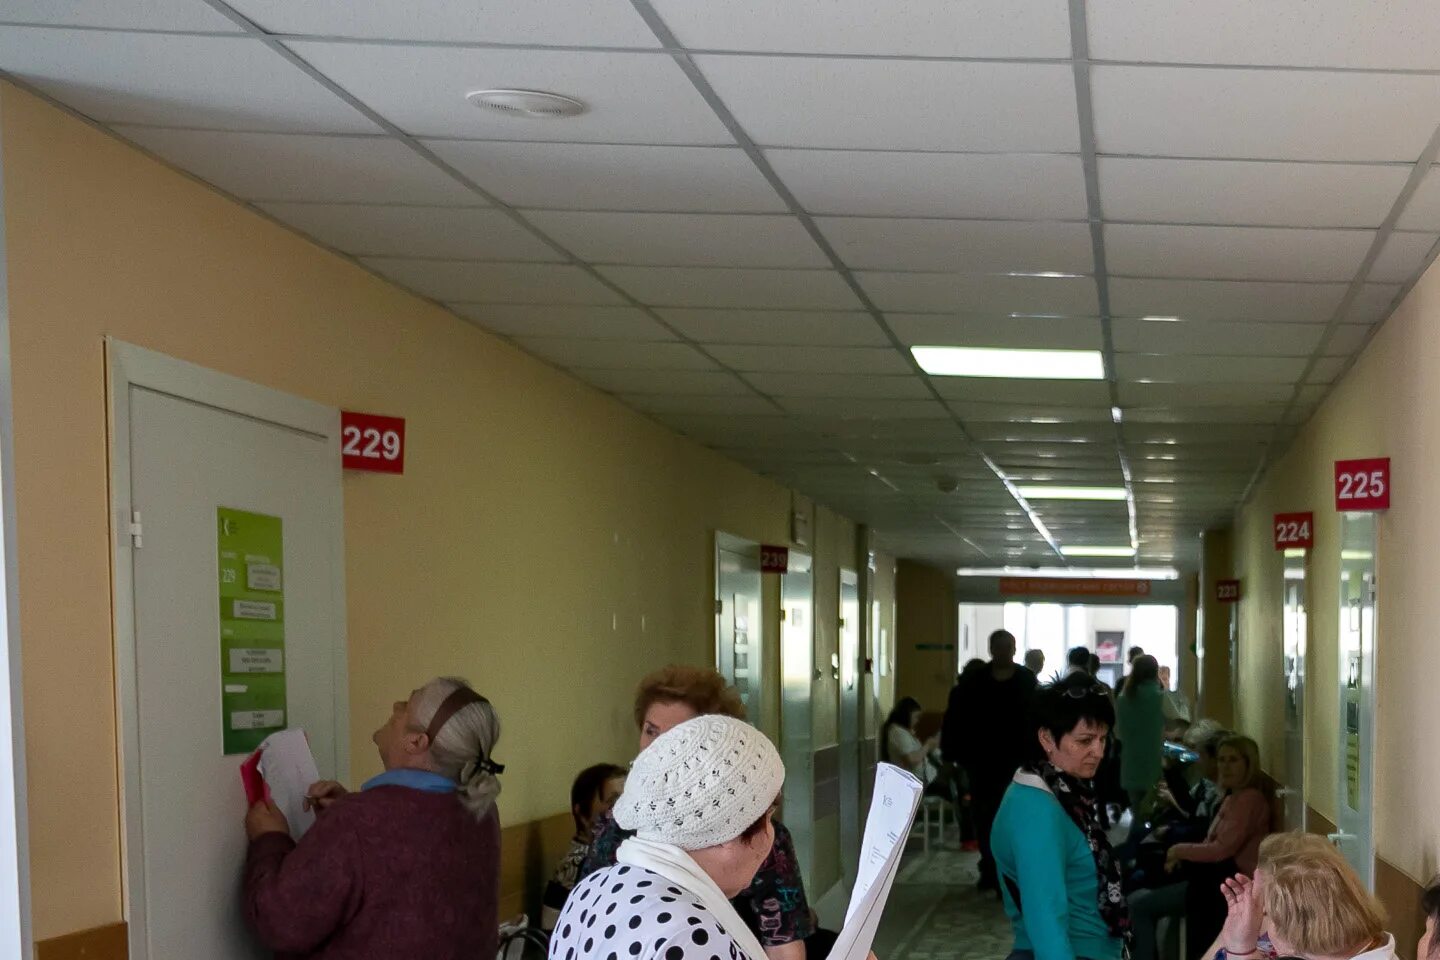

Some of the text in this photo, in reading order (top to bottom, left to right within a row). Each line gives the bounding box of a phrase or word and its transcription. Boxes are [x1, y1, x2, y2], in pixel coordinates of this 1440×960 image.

[342, 426, 400, 460] 229
[1338, 472, 1384, 499] 225
[1276, 521, 1310, 542] 224
